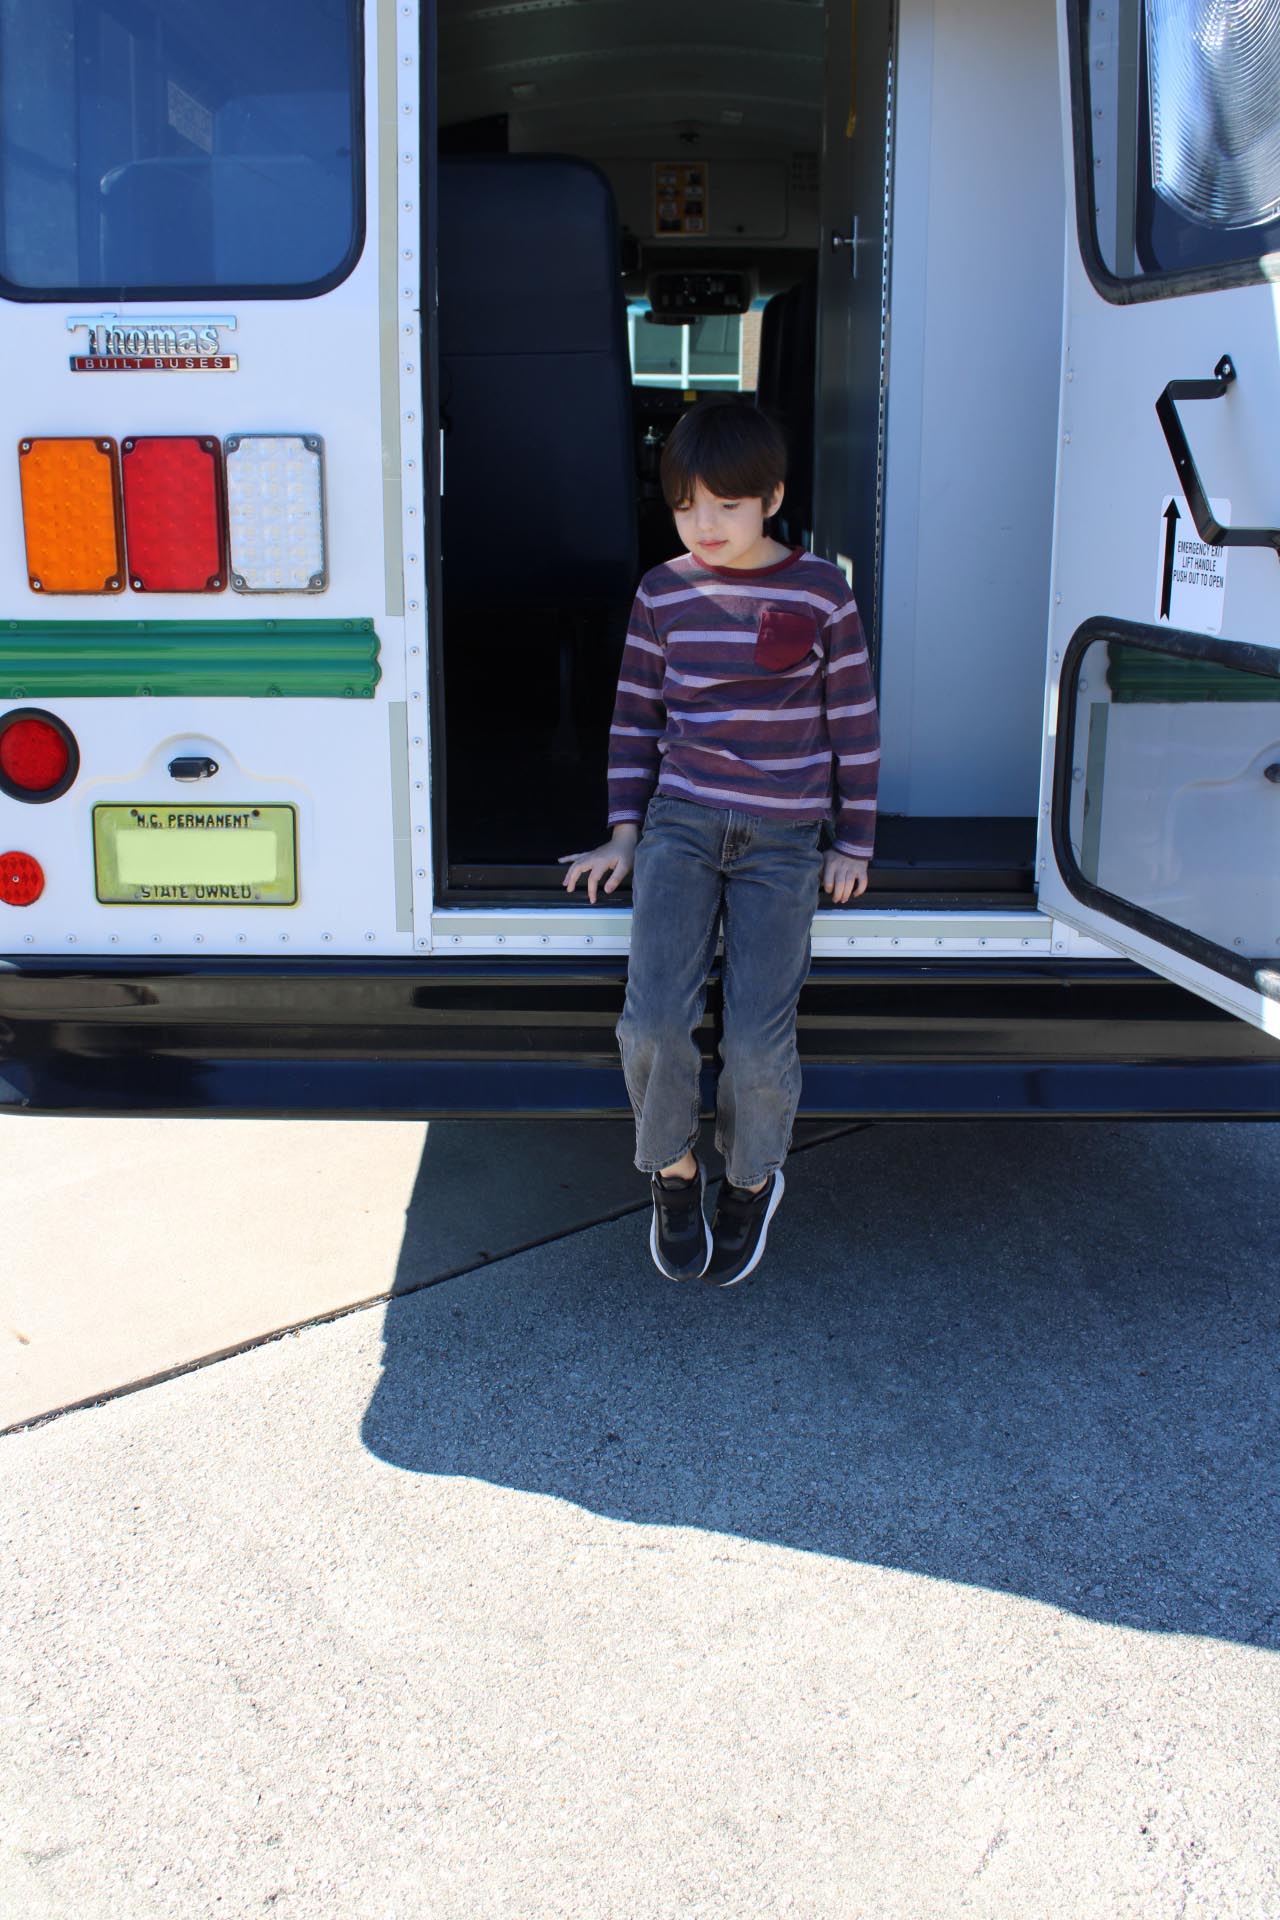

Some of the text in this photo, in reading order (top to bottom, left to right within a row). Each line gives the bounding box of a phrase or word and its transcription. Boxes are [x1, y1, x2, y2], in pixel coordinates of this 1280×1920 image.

[67, 312, 237, 355] Thomas
[85, 357, 224, 368] BUILT BUSES
[1177, 540, 1223, 557] EMERGENCY EXIT
[1182, 556, 1216, 572] LIFT HANDLE
[1173, 569, 1224, 588] PUSH OUT TO OPEN
[168, 813, 250, 829] PERMANENT
[141, 884, 252, 899] STATE OWNED
